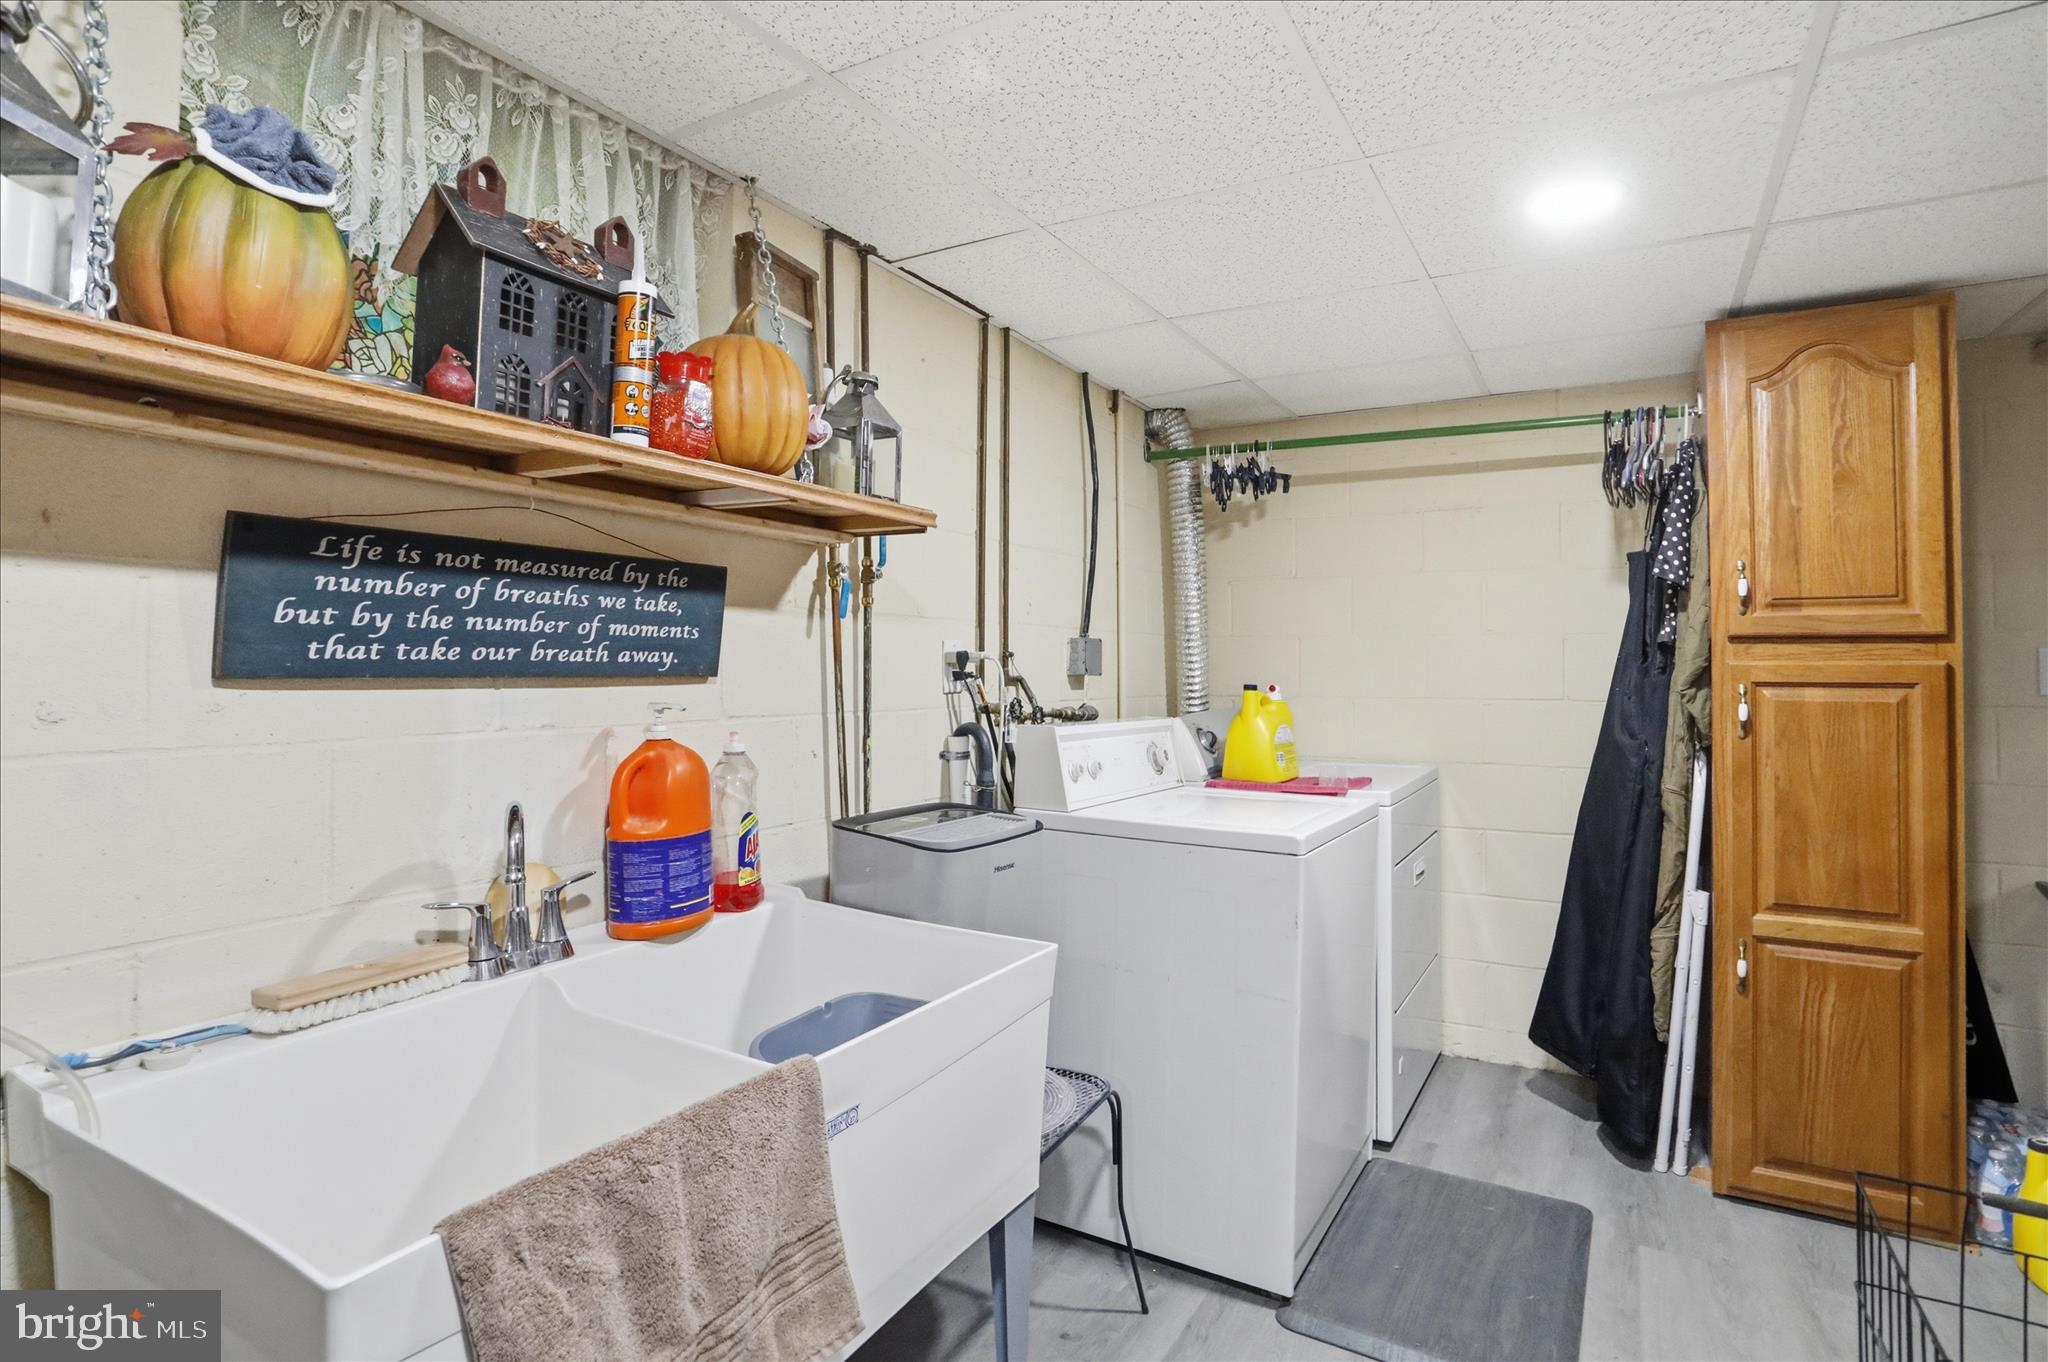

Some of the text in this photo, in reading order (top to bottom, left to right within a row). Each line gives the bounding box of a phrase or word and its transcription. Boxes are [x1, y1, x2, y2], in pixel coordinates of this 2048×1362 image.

[310, 535, 689, 592] Life is not measured by the
[314, 571, 682, 616] number of breaths we take,
[273, 597, 700, 644] but by the number of moments
[307, 633, 678, 671] that take our breath away.
